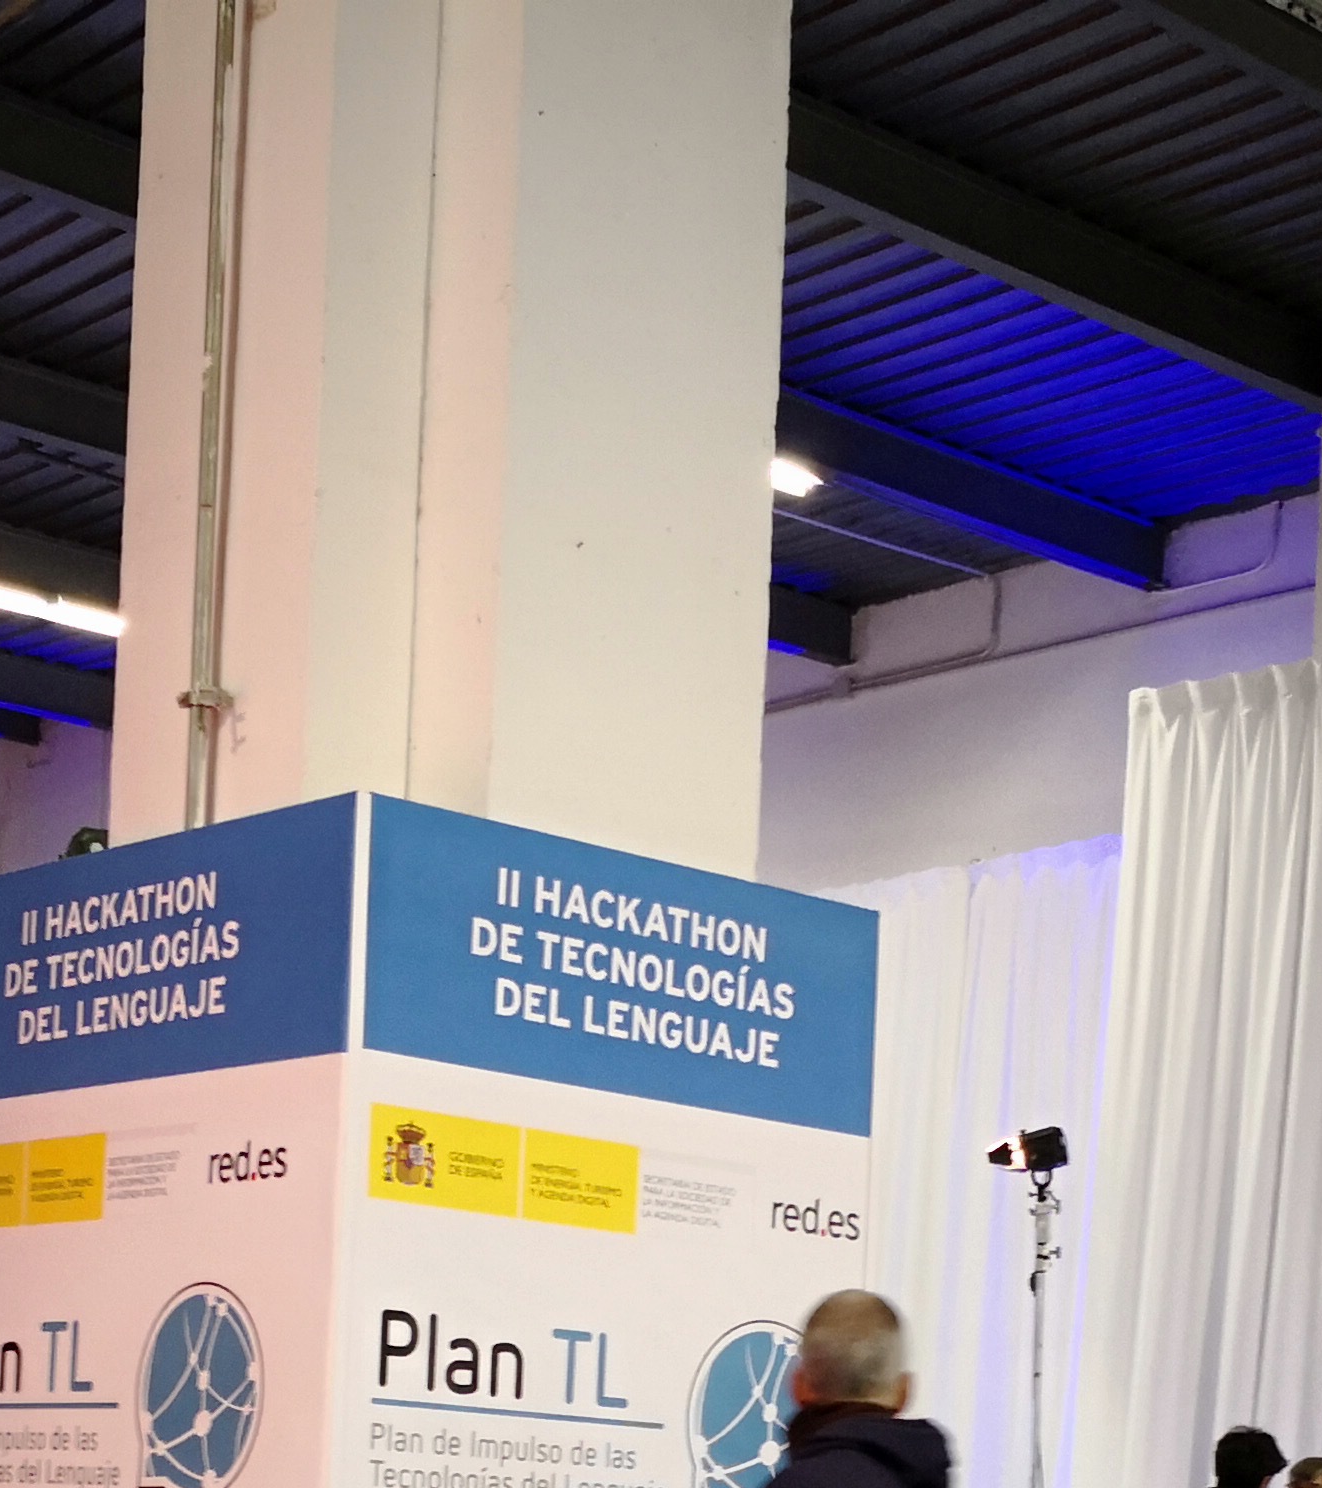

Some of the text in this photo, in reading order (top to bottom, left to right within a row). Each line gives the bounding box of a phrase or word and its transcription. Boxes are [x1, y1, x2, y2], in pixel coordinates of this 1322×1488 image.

[21, 872, 217, 946] II HACKATHON
[497, 868, 767, 962] II HACKATHON
[4, 918, 240, 997] DE TECNOLOGÍAS
[471, 916, 795, 1019] DE TECNOLOGÍAS
[18, 976, 226, 1044] DEL LENGUAJE
[495, 978, 779, 1068] DEL LENGUAJE
[207, 1140, 288, 1184] red.es
[771, 1199, 860, 1240] red.es
[41, 1320, 93, 1393] TL
[379, 1309, 627, 1409] Plan TL
[17, 1459, 41, 1484] del
[53, 1428, 73, 1451] de
[369, 1422, 637, 1472] Plan de Impulso de las
